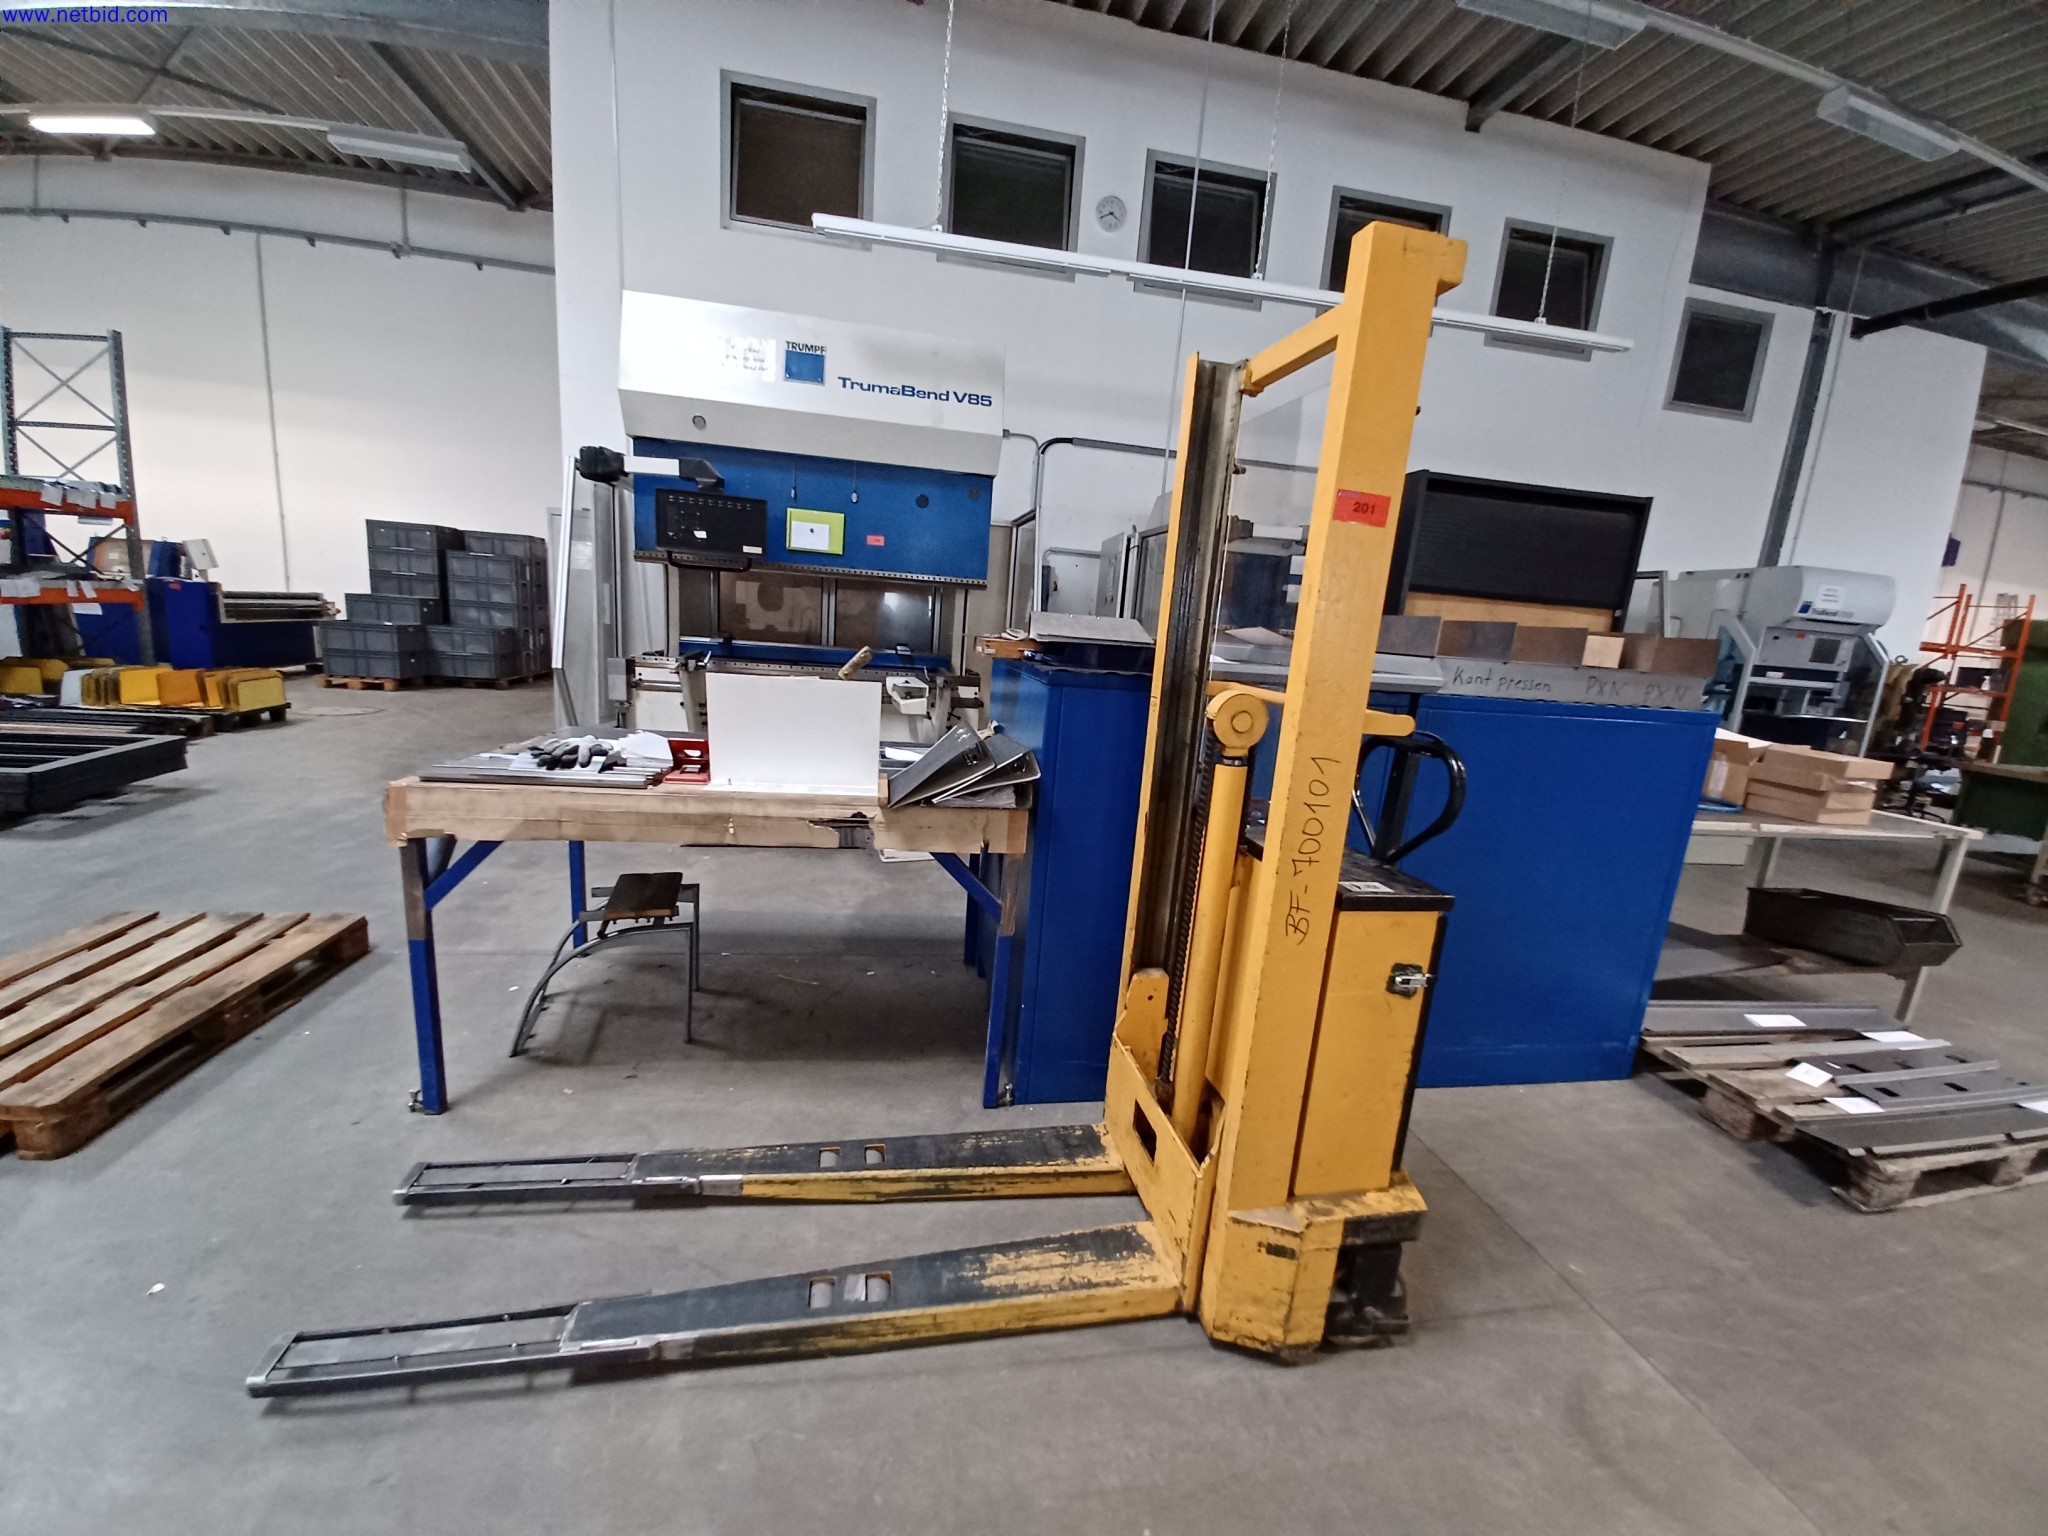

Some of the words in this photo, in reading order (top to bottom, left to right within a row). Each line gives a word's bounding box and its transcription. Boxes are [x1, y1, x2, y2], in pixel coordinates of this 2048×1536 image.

[785, 340, 826, 354] TRUMPF
[838, 376, 949, 402] TrumaBend
[953, 391, 992, 407] V85
[1352, 501, 1376, 515] 201
[1453, 666, 1491, 686] Kant
[1497, 677, 1551, 692] pressen
[1286, 757, 1341, 946] BF-700101
